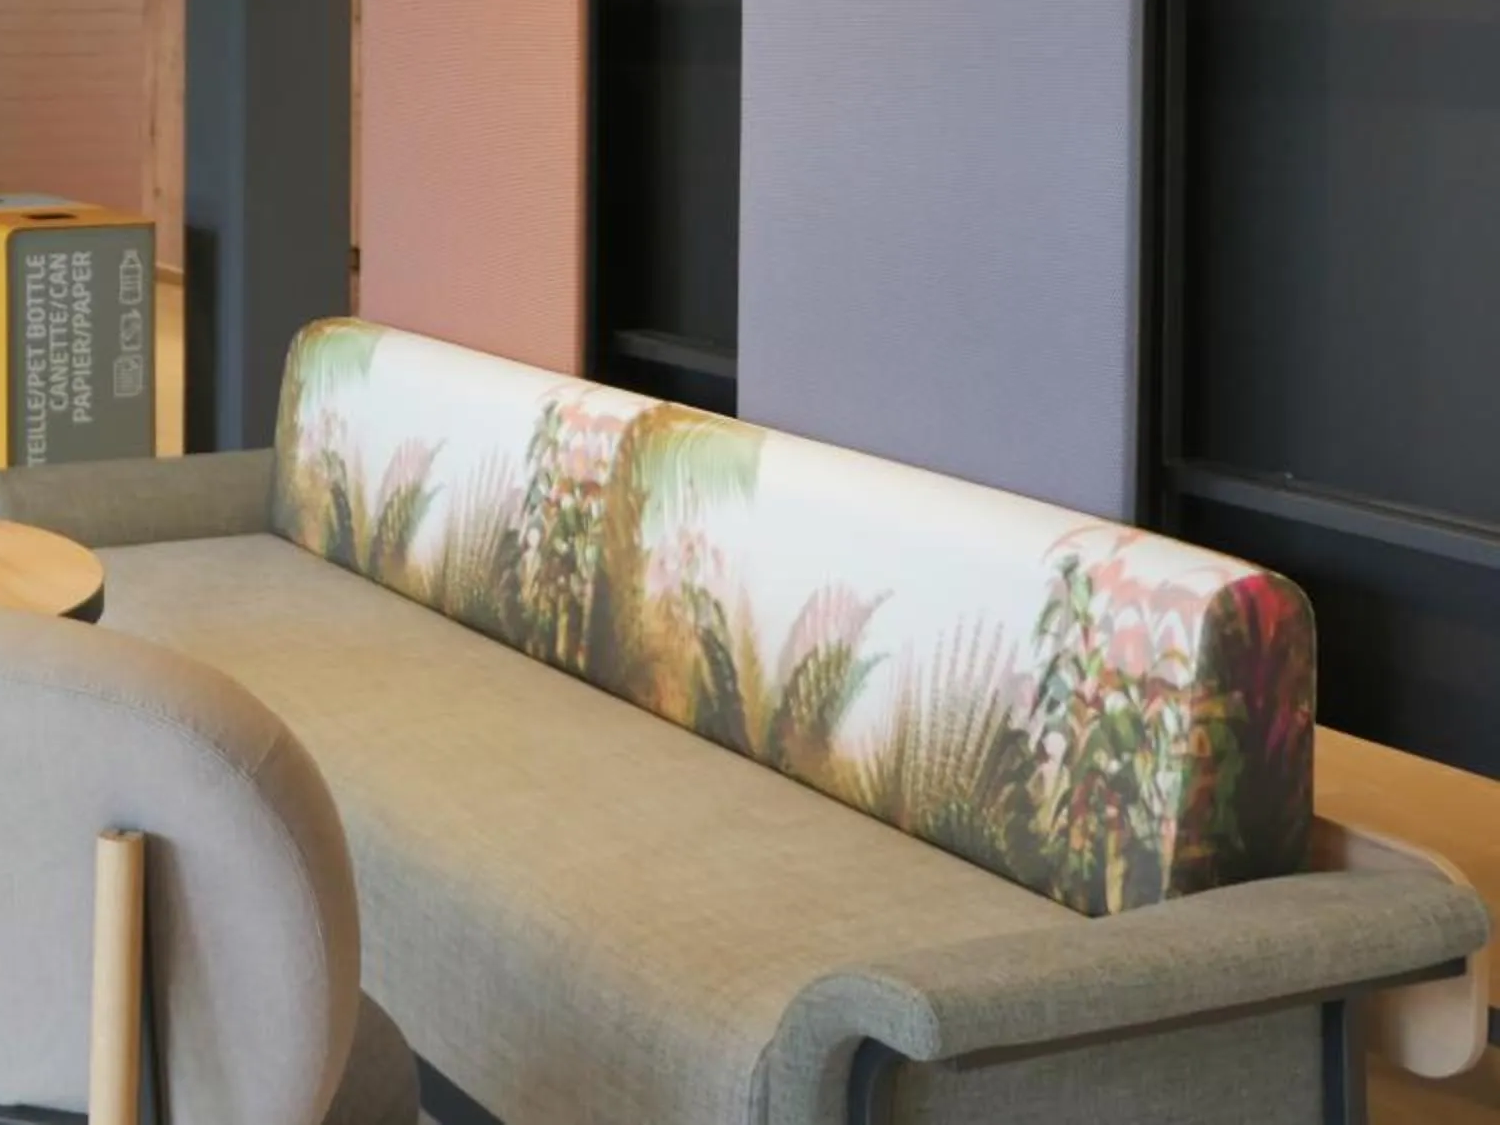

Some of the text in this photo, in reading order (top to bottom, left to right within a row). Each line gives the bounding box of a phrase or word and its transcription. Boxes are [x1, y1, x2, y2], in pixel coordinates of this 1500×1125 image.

[26, 254, 48, 339] BOTTLE
[49, 252, 69, 411] CANETTE/CAN
[71, 251, 93, 423] PAPIER/PAPER
